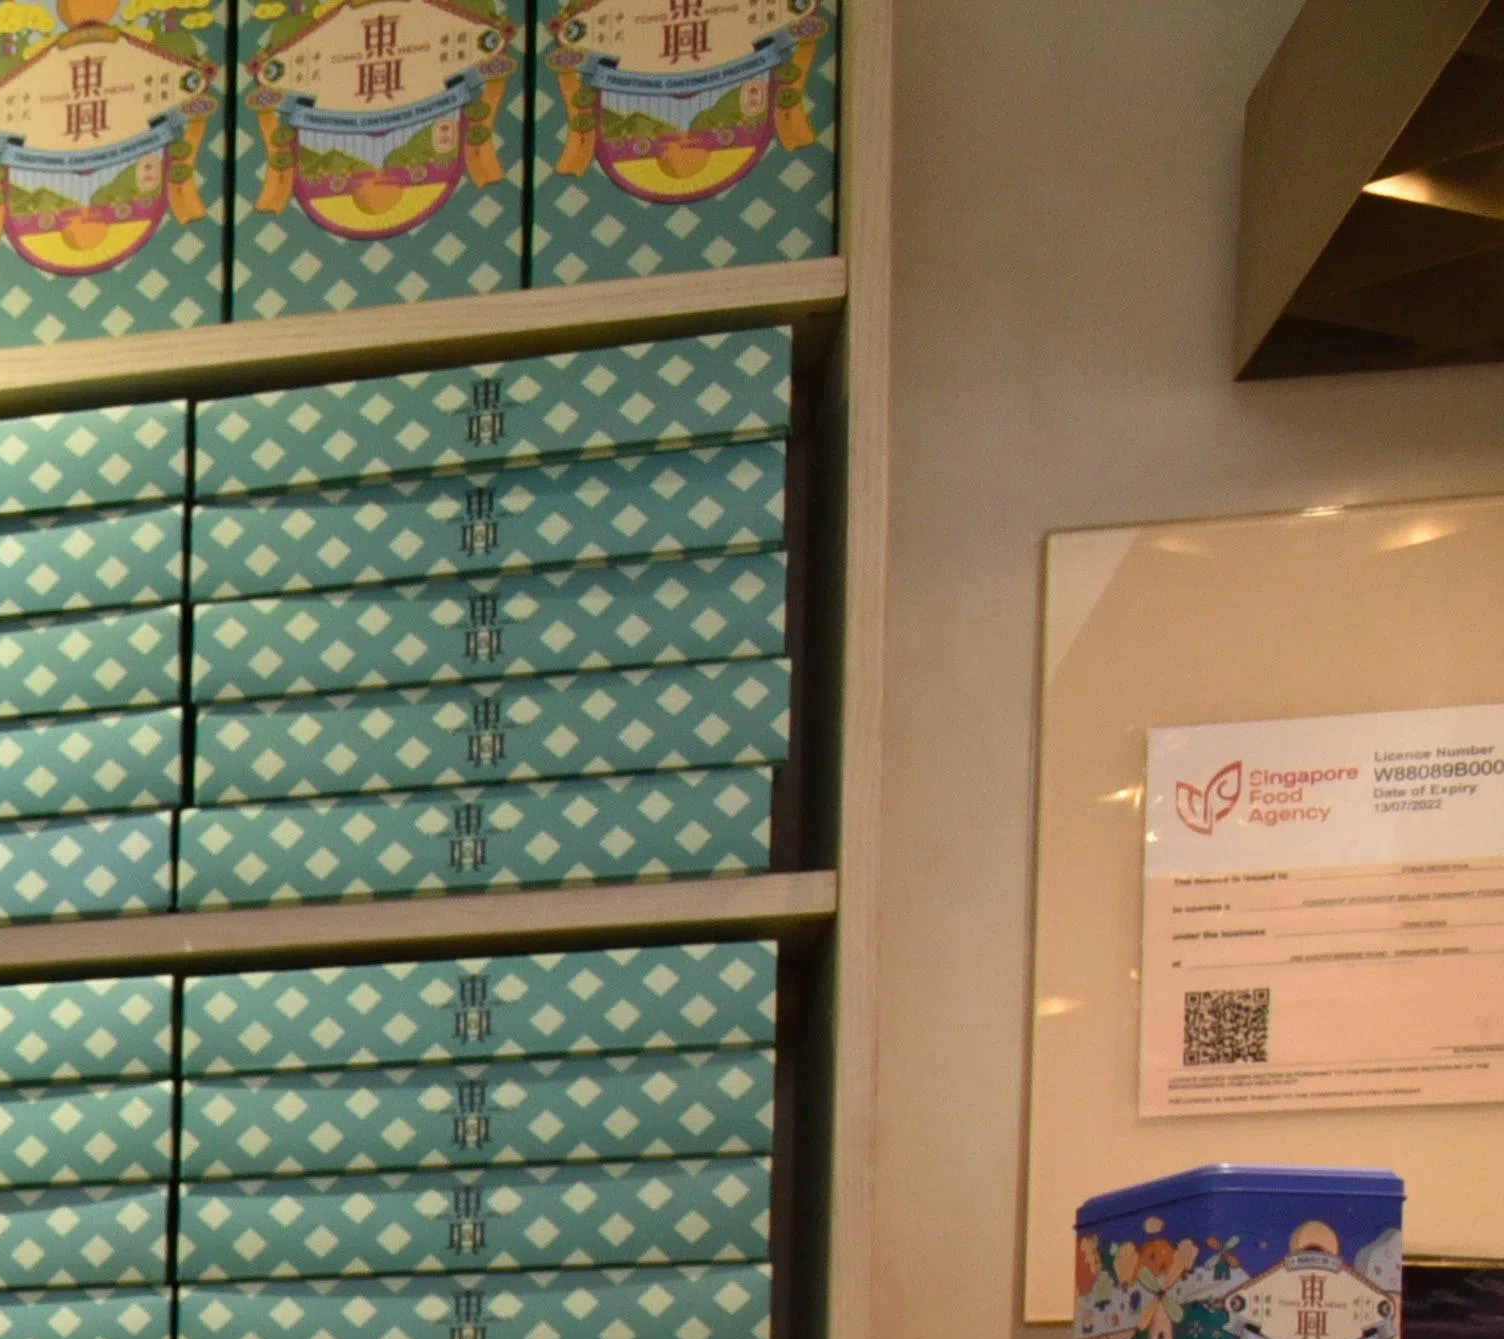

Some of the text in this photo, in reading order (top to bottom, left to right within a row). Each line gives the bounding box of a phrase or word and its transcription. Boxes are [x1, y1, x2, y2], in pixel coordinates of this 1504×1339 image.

[1436, 745, 1495, 757] Number
[1249, 766, 1359, 788] Singapore
[1249, 787, 1303, 804] Food
[1373, 783, 1478, 800] Date of Expiry
[1248, 806, 1332, 825] Agency
